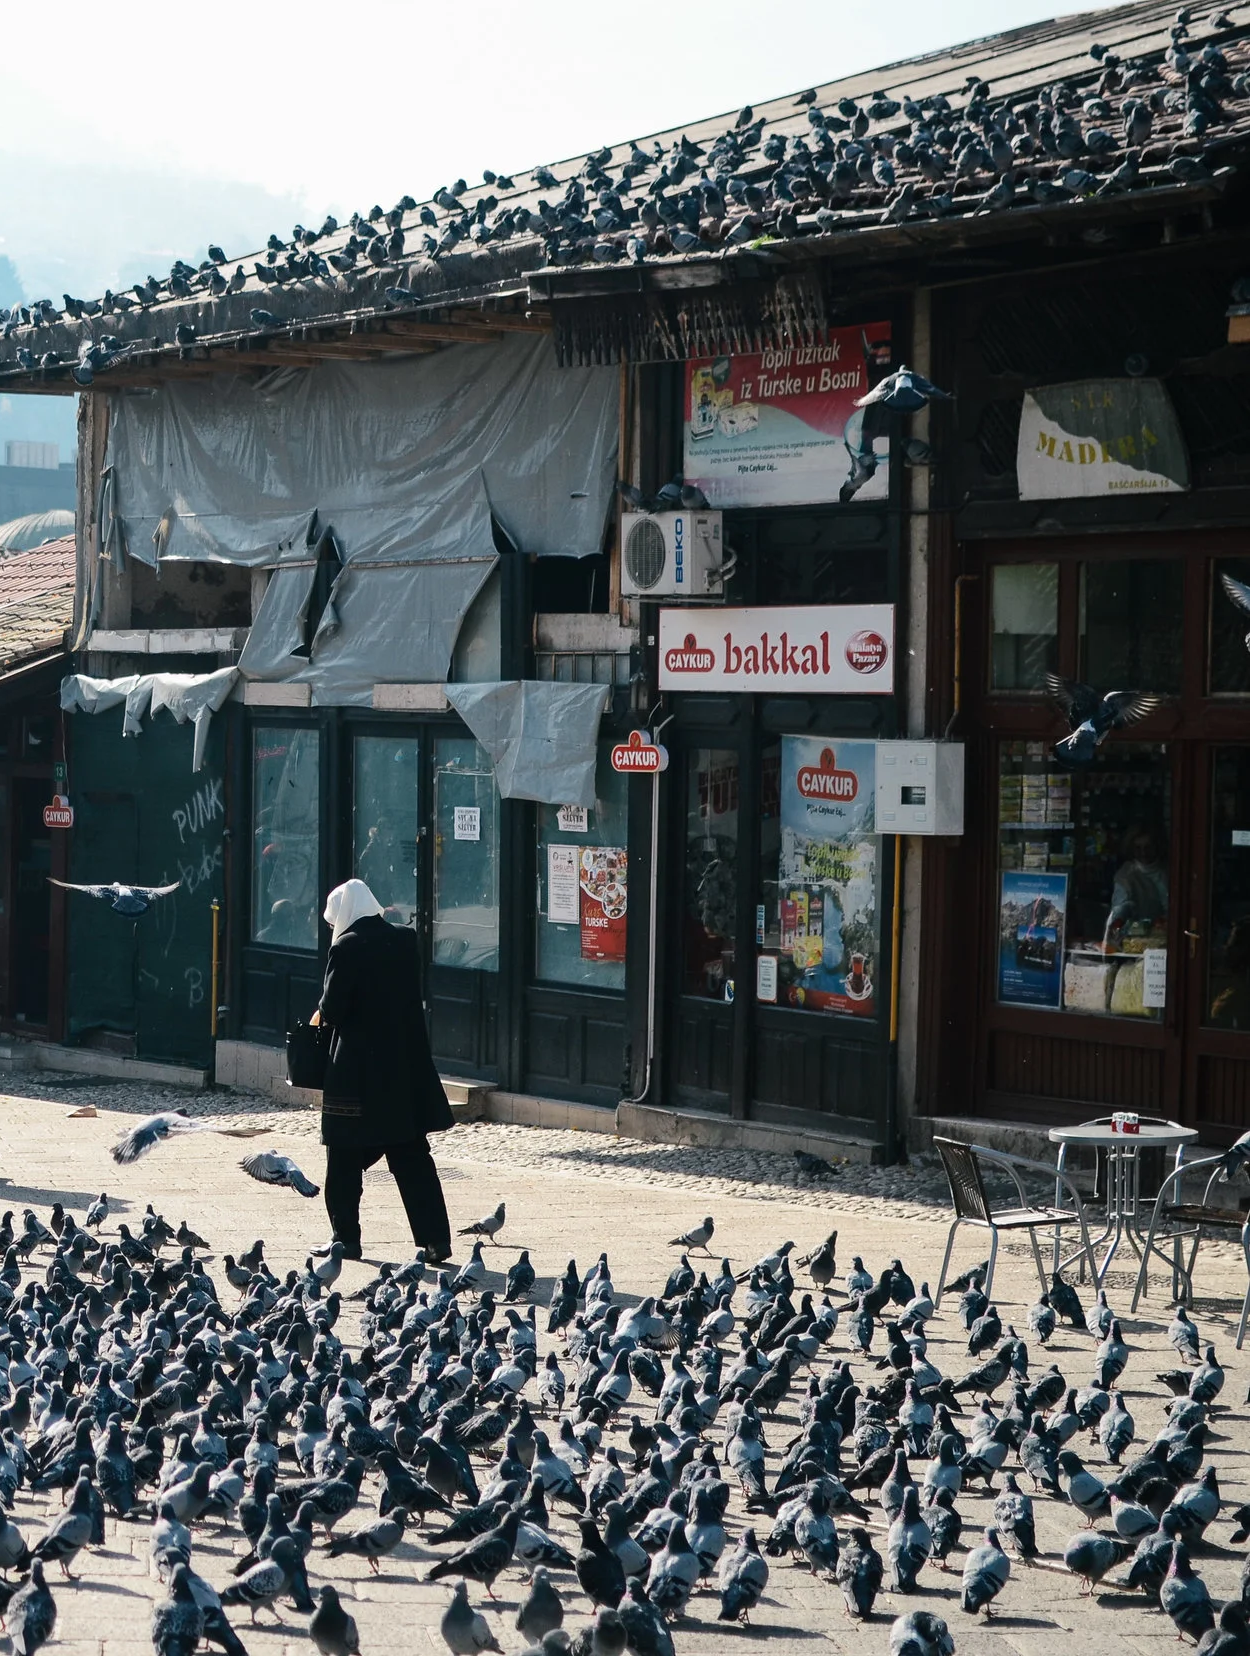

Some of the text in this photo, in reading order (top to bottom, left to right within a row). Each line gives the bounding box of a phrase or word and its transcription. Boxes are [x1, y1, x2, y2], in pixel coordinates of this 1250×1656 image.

[795, 338, 841, 366] užitak
[740, 365, 860, 400] iz Turske u Bosni
[1035, 423, 1159, 465] MADERA
[738, 465, 749, 474] Pijte
[675, 518, 684, 584] BEKO
[669, 652, 711, 670] ÇAYKUR
[723, 631, 830, 675] bakkal
[55, 766, 64, 777] 13
[614, 750, 657, 768] ÇAYKUR
[801, 772, 854, 797] ÇAYKUR
[172, 777, 225, 844] PUNK
[585, 917, 609, 928] TURSKE
